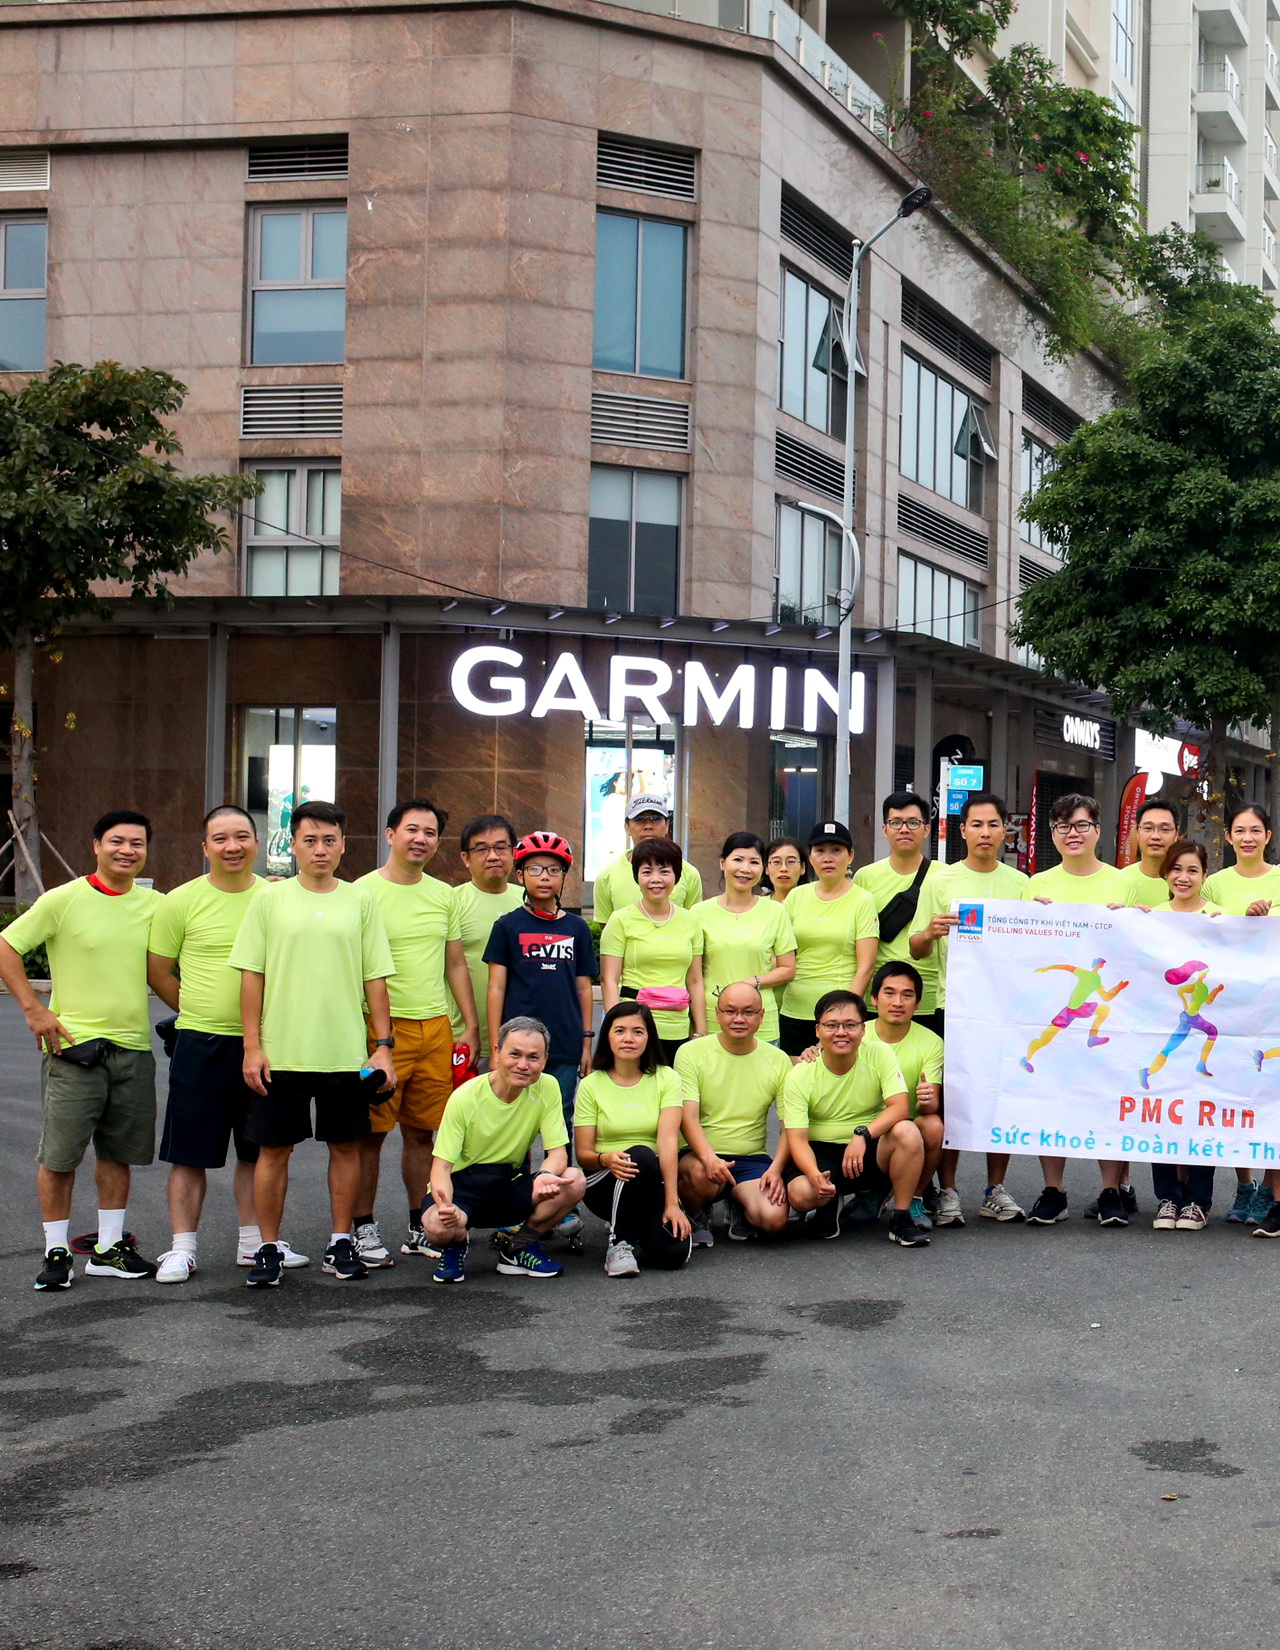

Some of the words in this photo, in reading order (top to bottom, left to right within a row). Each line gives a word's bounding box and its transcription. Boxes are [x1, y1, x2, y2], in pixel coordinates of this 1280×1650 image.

[450, 645, 866, 734] GARMIN
[1063, 714, 1100, 749] ONWAYS
[987, 913, 1008, 924] TỔNG
[1008, 916, 1029, 925] CÔNG
[1031, 918, 1039, 926] TY
[1040, 917, 1053, 926] KHÍ
[1072, 921, 1089, 929] NAM
[1094, 922, 1113, 930] CTCP
[987, 926, 1023, 934] FUELLING
[1024, 928, 1052, 936] VALUES
[1054, 929, 1063, 937] TO
[1119, 1096, 1184, 1125] PMC
[1198, 1100, 1255, 1129] Run
[990, 1125, 1031, 1146] Sức
[1039, 1128, 1096, 1150] khoẻ
[1121, 1133, 1179, 1155] Đoàn
[1188, 1137, 1224, 1158] kết
